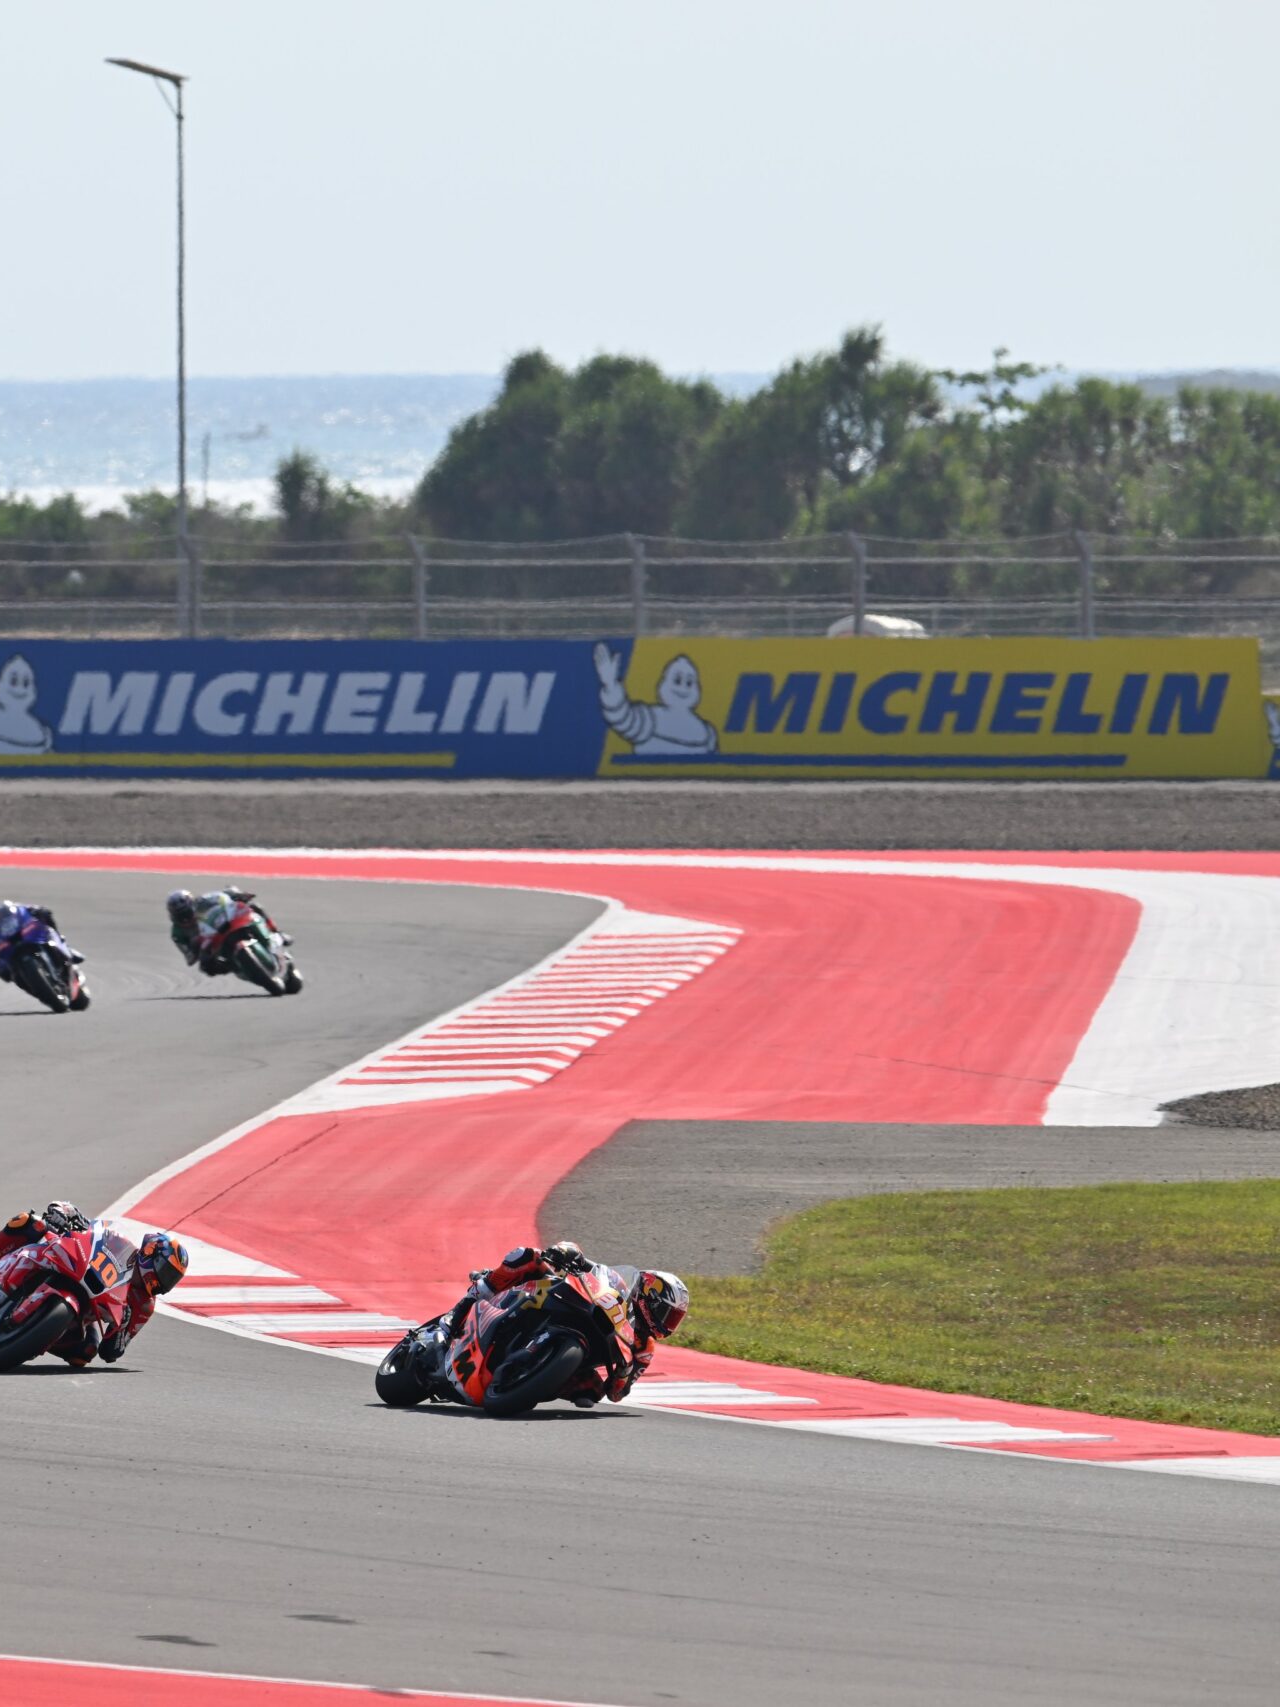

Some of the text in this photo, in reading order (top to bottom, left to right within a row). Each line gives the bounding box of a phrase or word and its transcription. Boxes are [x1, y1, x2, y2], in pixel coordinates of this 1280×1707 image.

[58, 671, 557, 735] MICHELIN
[723, 672, 1230, 735] MICHELIN
[90, 1251, 118, 1288] 10
[596, 1293, 625, 1325] 37
